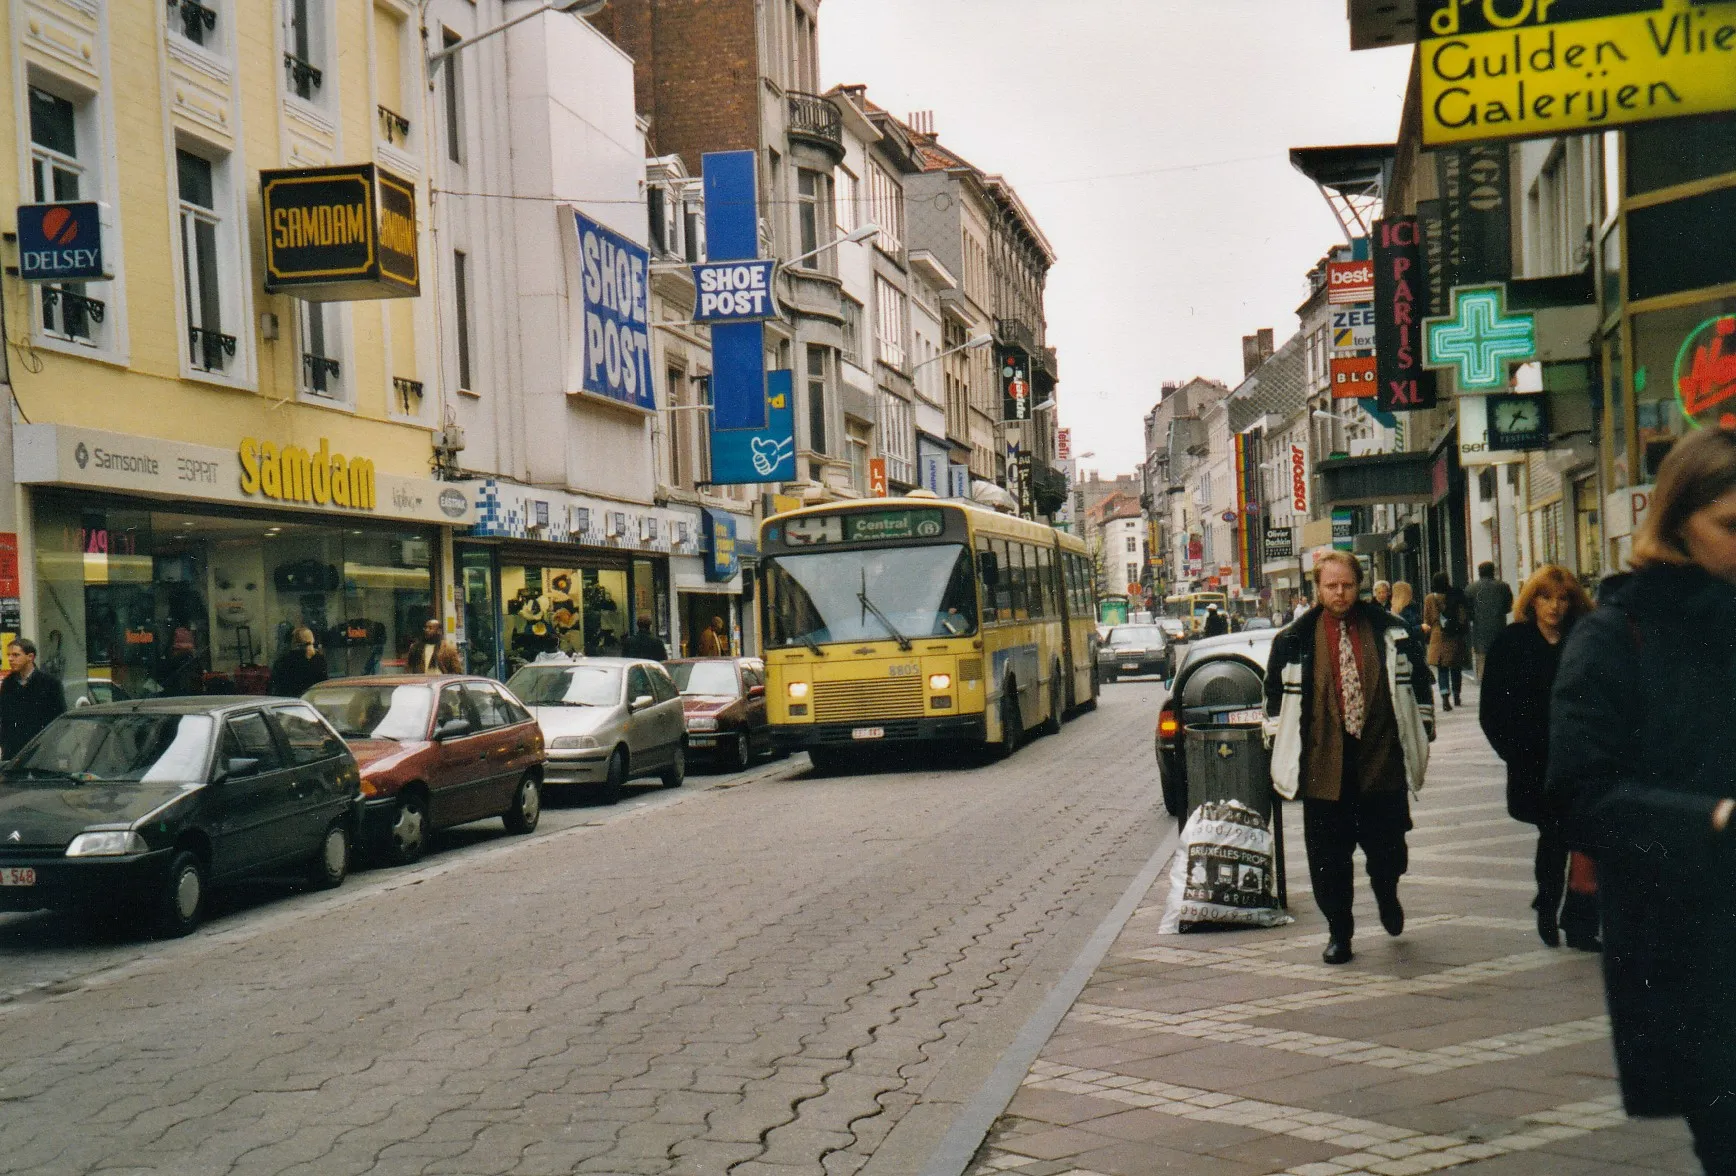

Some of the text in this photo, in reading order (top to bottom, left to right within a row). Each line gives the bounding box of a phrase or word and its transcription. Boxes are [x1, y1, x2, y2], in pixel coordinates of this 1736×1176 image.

[1433, 30, 1627, 81] Gulden
[1434, 70, 1682, 128] Galerijen
[274, 203, 364, 249] SAMDAM
[380, 206, 413, 257] SAMDAM
[1382, 222, 1420, 248] ICI
[24, 249, 98, 271] DELSEY
[584, 231, 645, 323] SHOE
[700, 266, 765, 291] SHOE
[701, 290, 766, 316] POST
[1393, 257, 1414, 369] PARIS
[1333, 311, 1375, 328] ZEE
[586, 312, 648, 398] POST
[1390, 380, 1424, 404] XL
[94, 448, 159, 475] Samsonite
[177, 457, 218, 483] ESPRIT
[240, 437, 375, 510] samdam
[856, 518, 907, 530] Central
[11, 869, 33, 884] 548
